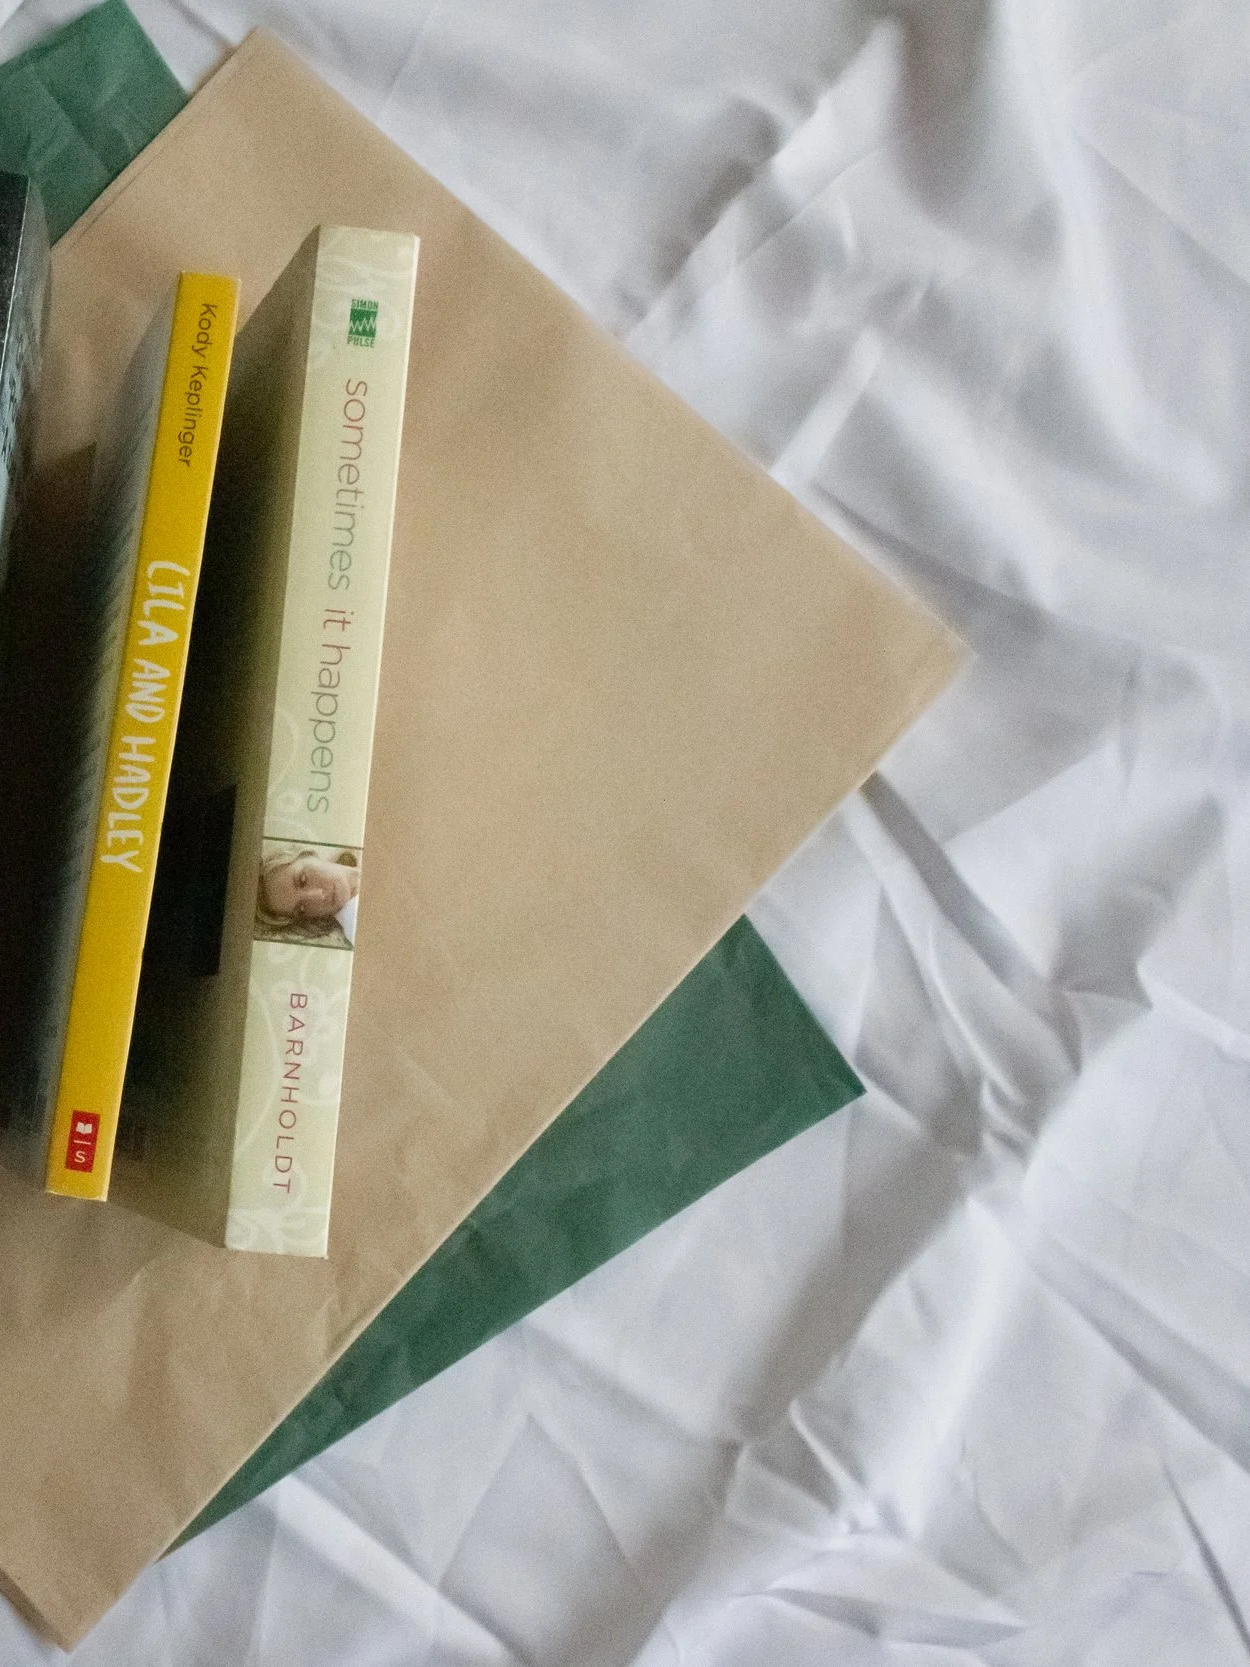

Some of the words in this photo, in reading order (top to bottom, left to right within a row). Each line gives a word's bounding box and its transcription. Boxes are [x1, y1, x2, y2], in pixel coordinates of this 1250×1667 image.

[188, 303, 217, 360] Kody
[347, 335, 376, 348] PULSE
[350, 298, 379, 310] SIMON
[178, 365, 209, 468] Keplinger
[328, 378, 368, 591] sometimes
[138, 560, 191, 646] LILA
[322, 606, 354, 633] it
[125, 657, 171, 724] AND
[307, 642, 352, 814] happens
[100, 735, 156, 874] HADLEY
[271, 991, 309, 1195] BARNHOLDT
